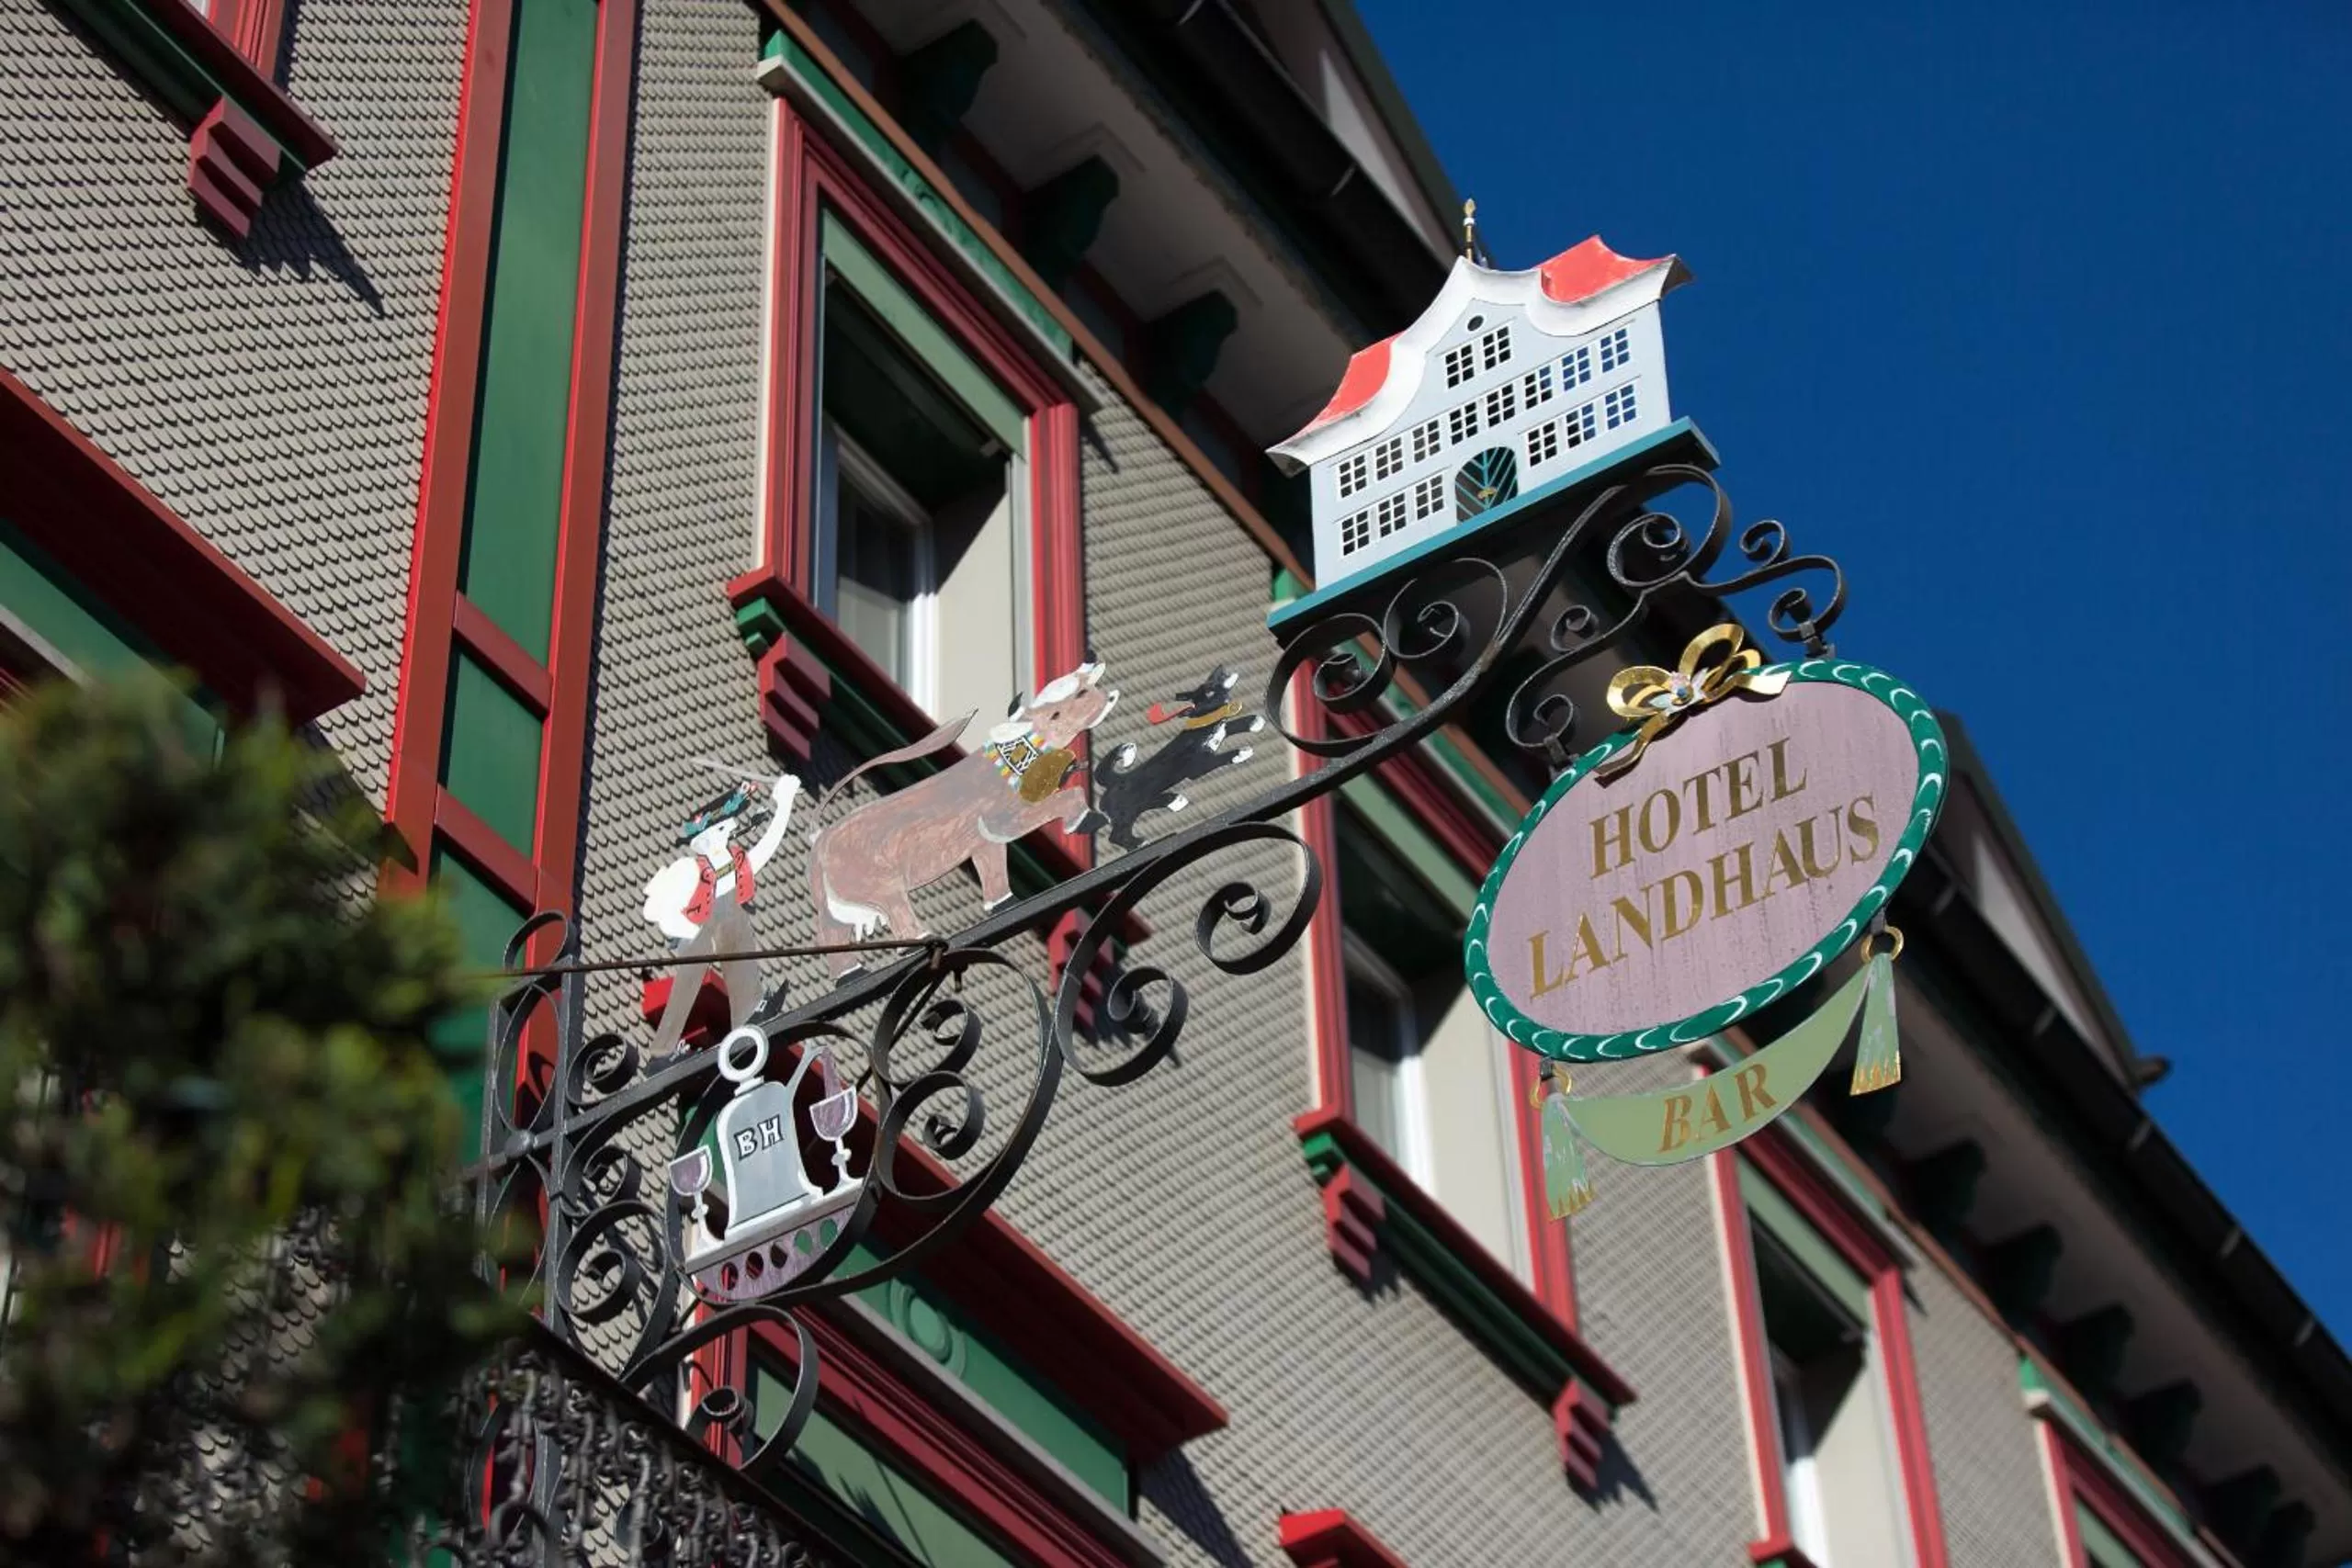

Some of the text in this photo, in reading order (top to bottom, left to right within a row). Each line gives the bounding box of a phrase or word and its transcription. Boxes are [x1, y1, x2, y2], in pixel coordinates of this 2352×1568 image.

[1589, 738, 1807, 880] HOTEL
[1527, 794, 1881, 999] LANDHAUS
[734, 1114, 784, 1160] BH
[1658, 1064, 1778, 1153] BAR
